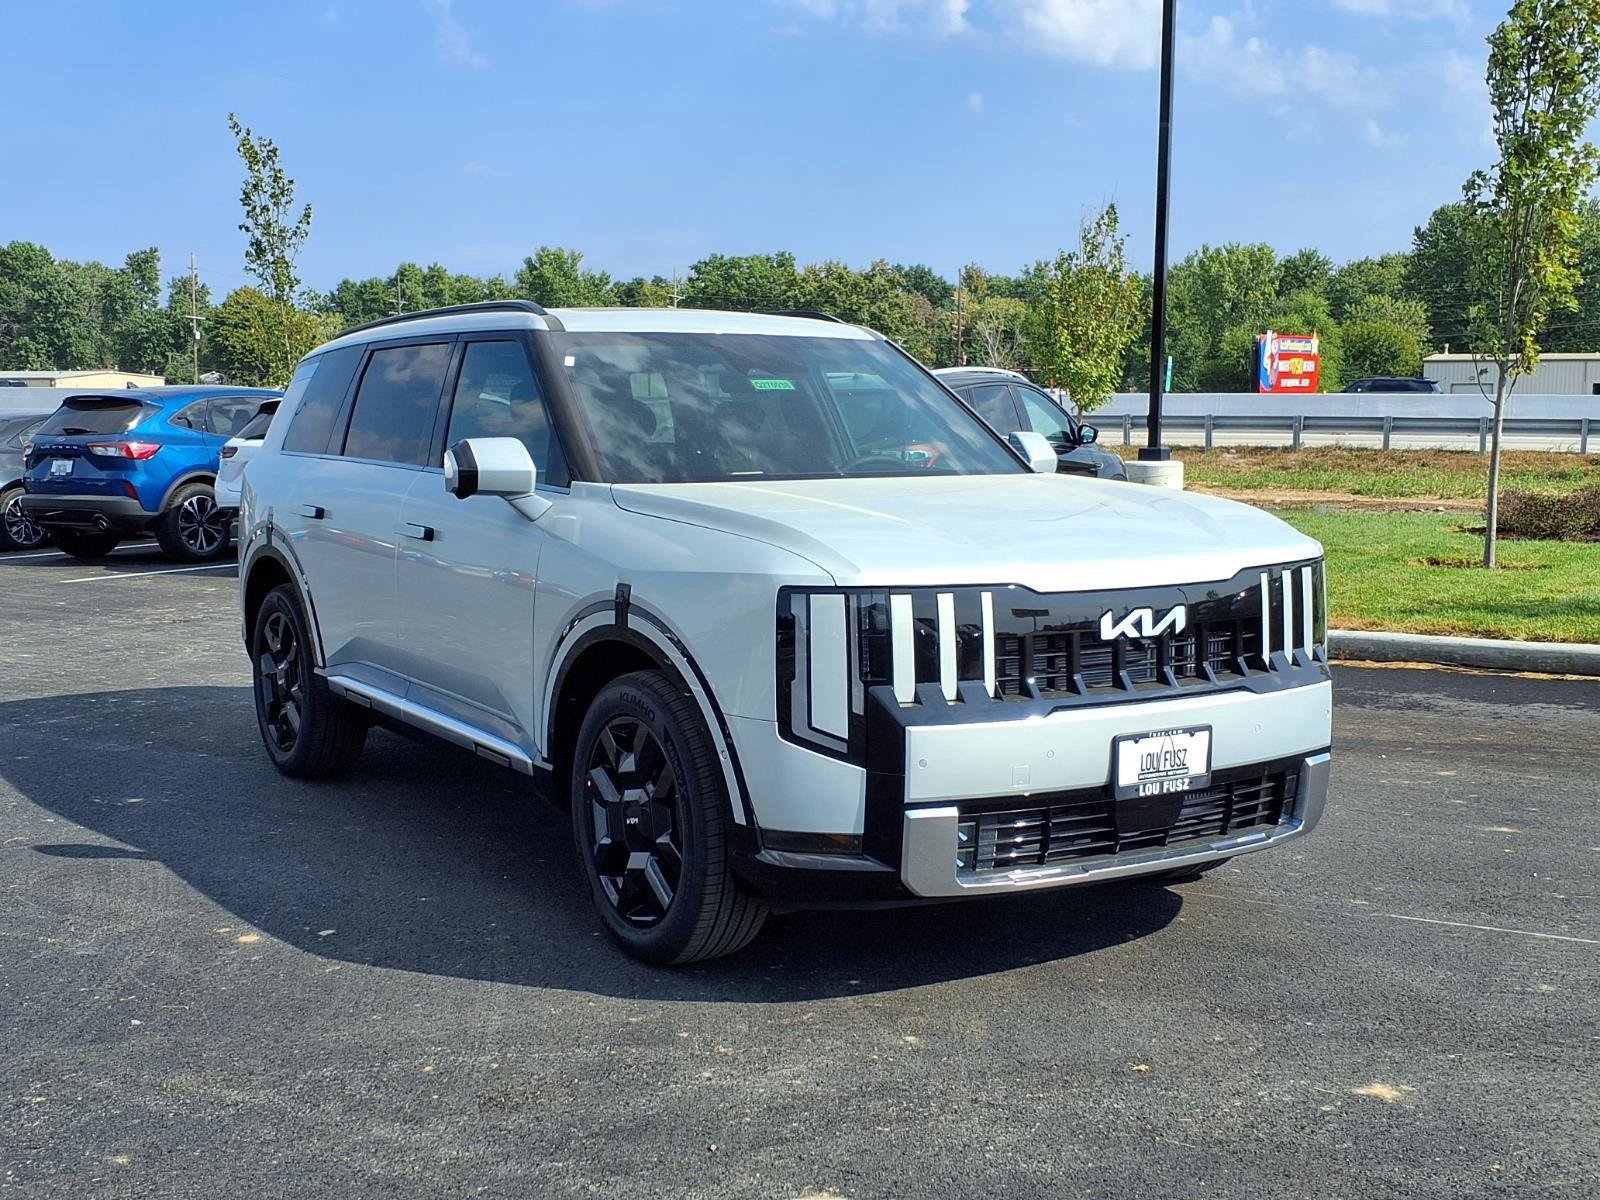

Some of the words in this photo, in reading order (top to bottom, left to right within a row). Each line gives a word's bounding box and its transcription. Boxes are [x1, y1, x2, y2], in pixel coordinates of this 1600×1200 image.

[1100, 604, 1186, 641] KIA
[619, 691, 656, 722] KUMHO
[1140, 752, 1159, 772] LOU
[1163, 748, 1188, 769] FUSZ
[1139, 782, 1160, 797] LOU
[1163, 778, 1190, 793] FUSZ
